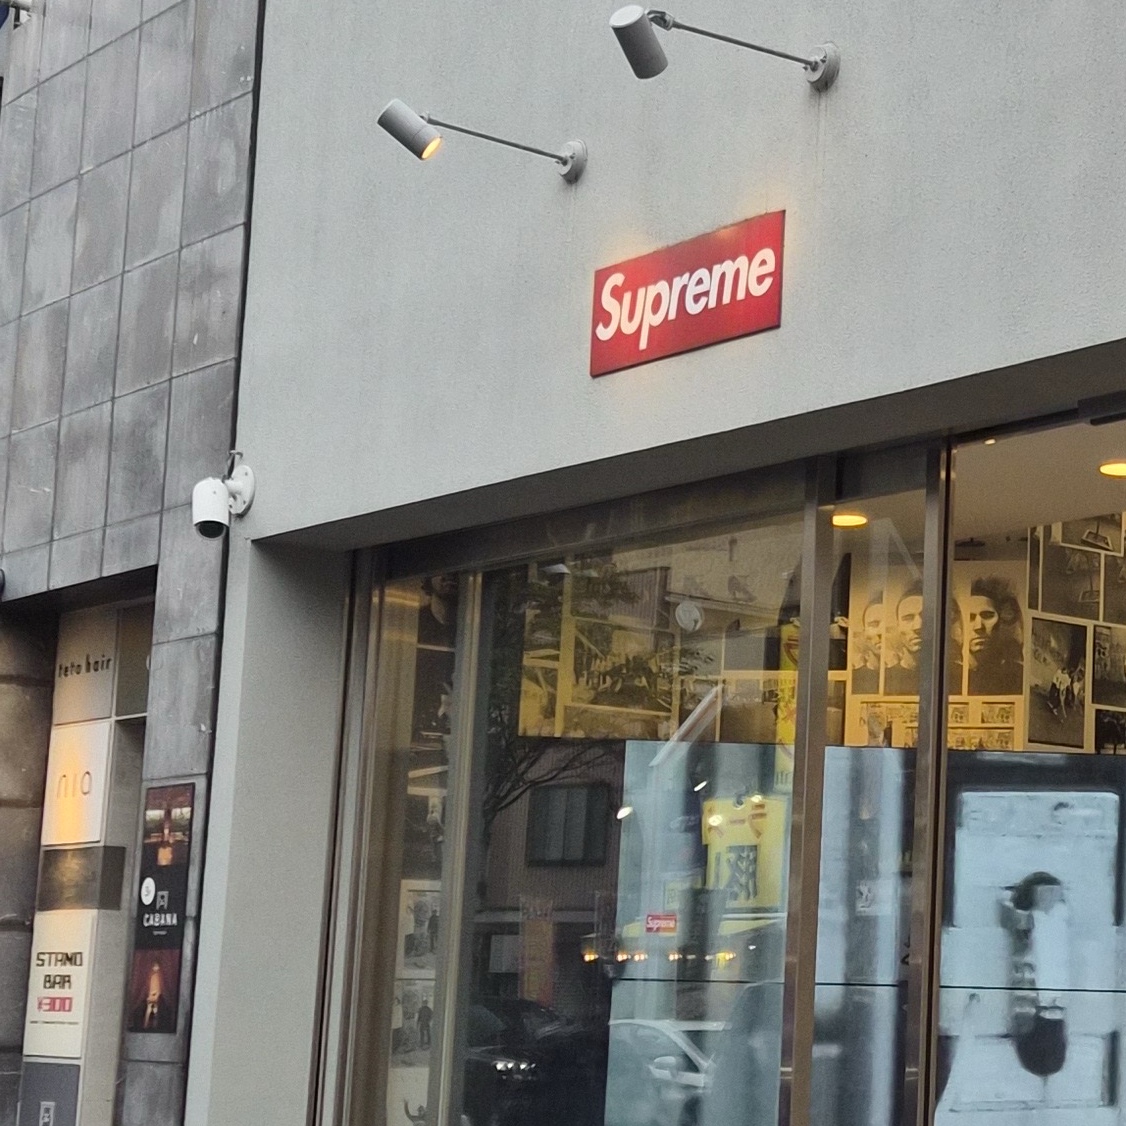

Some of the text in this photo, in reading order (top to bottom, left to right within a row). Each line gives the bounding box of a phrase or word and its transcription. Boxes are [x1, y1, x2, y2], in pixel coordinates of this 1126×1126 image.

[595, 248, 776, 351] Supreme
[85, 654, 112, 673] hair
[142, 912, 178, 928] CABANA
[36, 952, 83, 967] STAND
[43, 974, 72, 990] BAR
